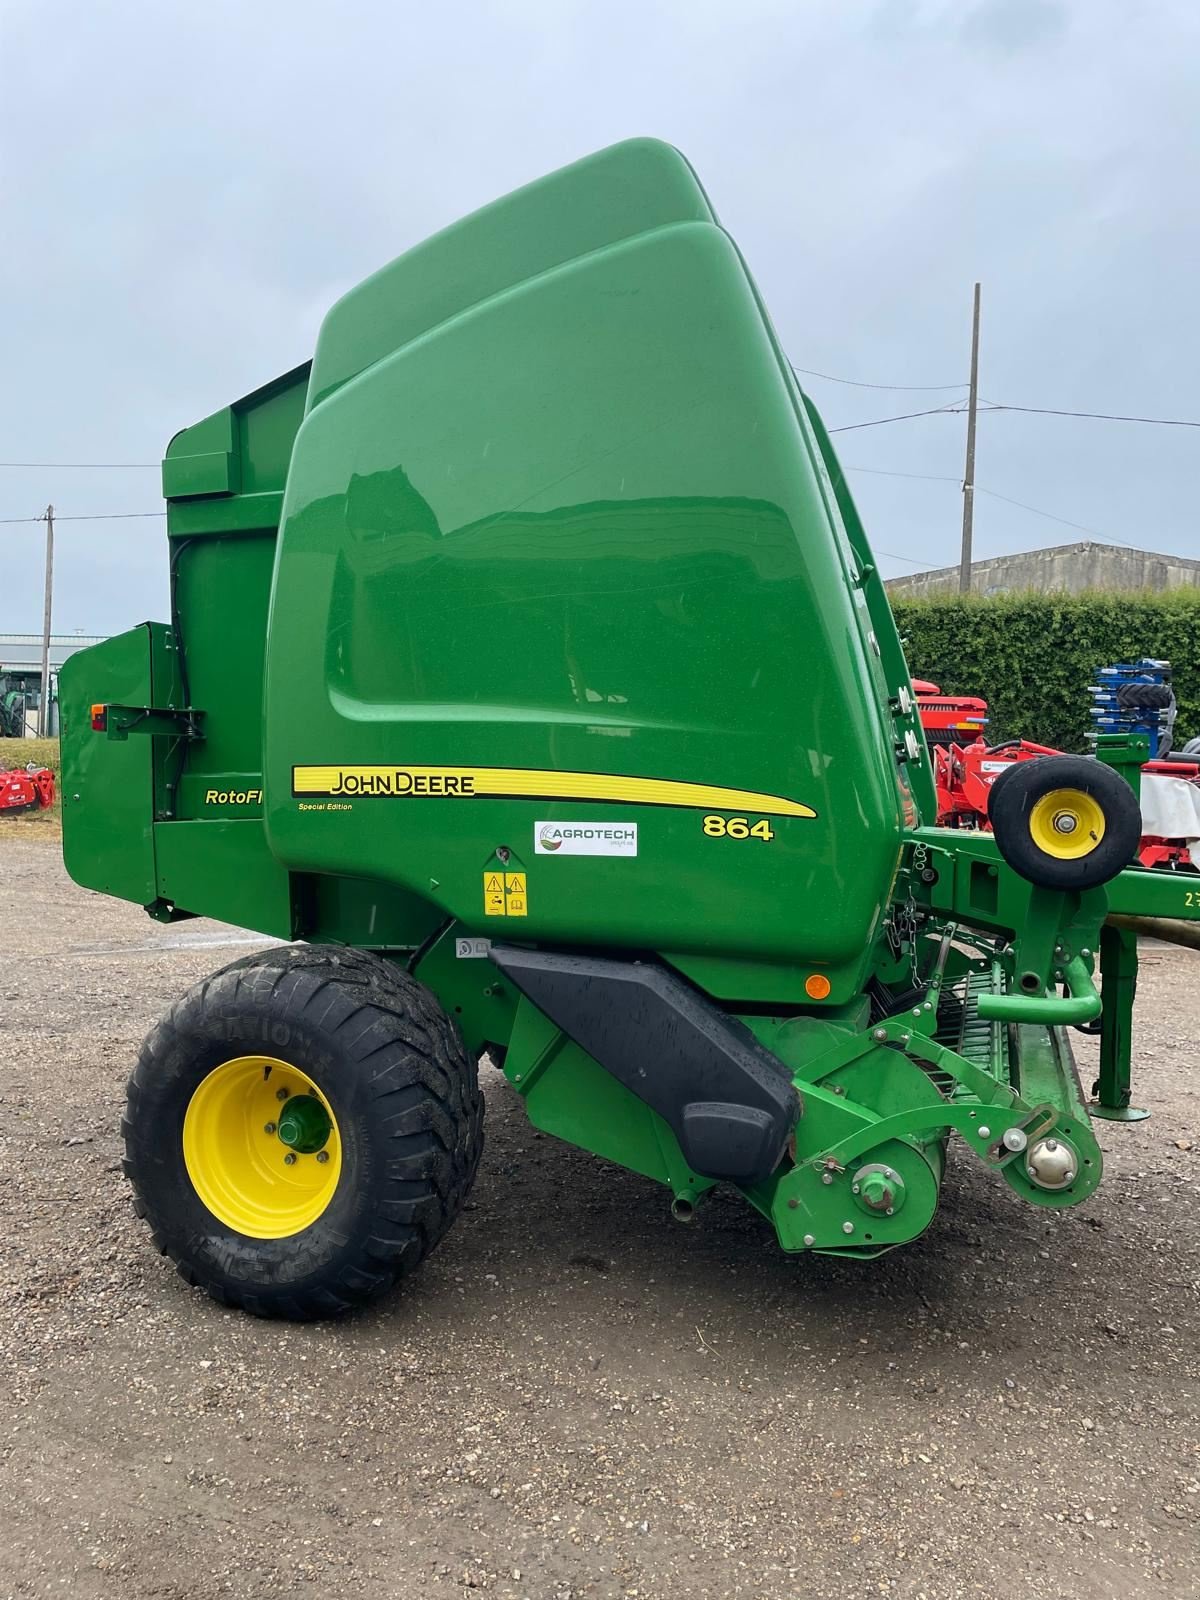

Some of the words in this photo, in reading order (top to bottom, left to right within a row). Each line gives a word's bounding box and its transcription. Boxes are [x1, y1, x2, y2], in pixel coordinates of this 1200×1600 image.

[332, 771, 391, 792] JOHN
[395, 772, 475, 794] DEERE
[298, 803, 325, 812] Special
[327, 802, 353, 811] Edition
[552, 829, 635, 840] AGROTECH
[703, 815, 775, 842] 864
